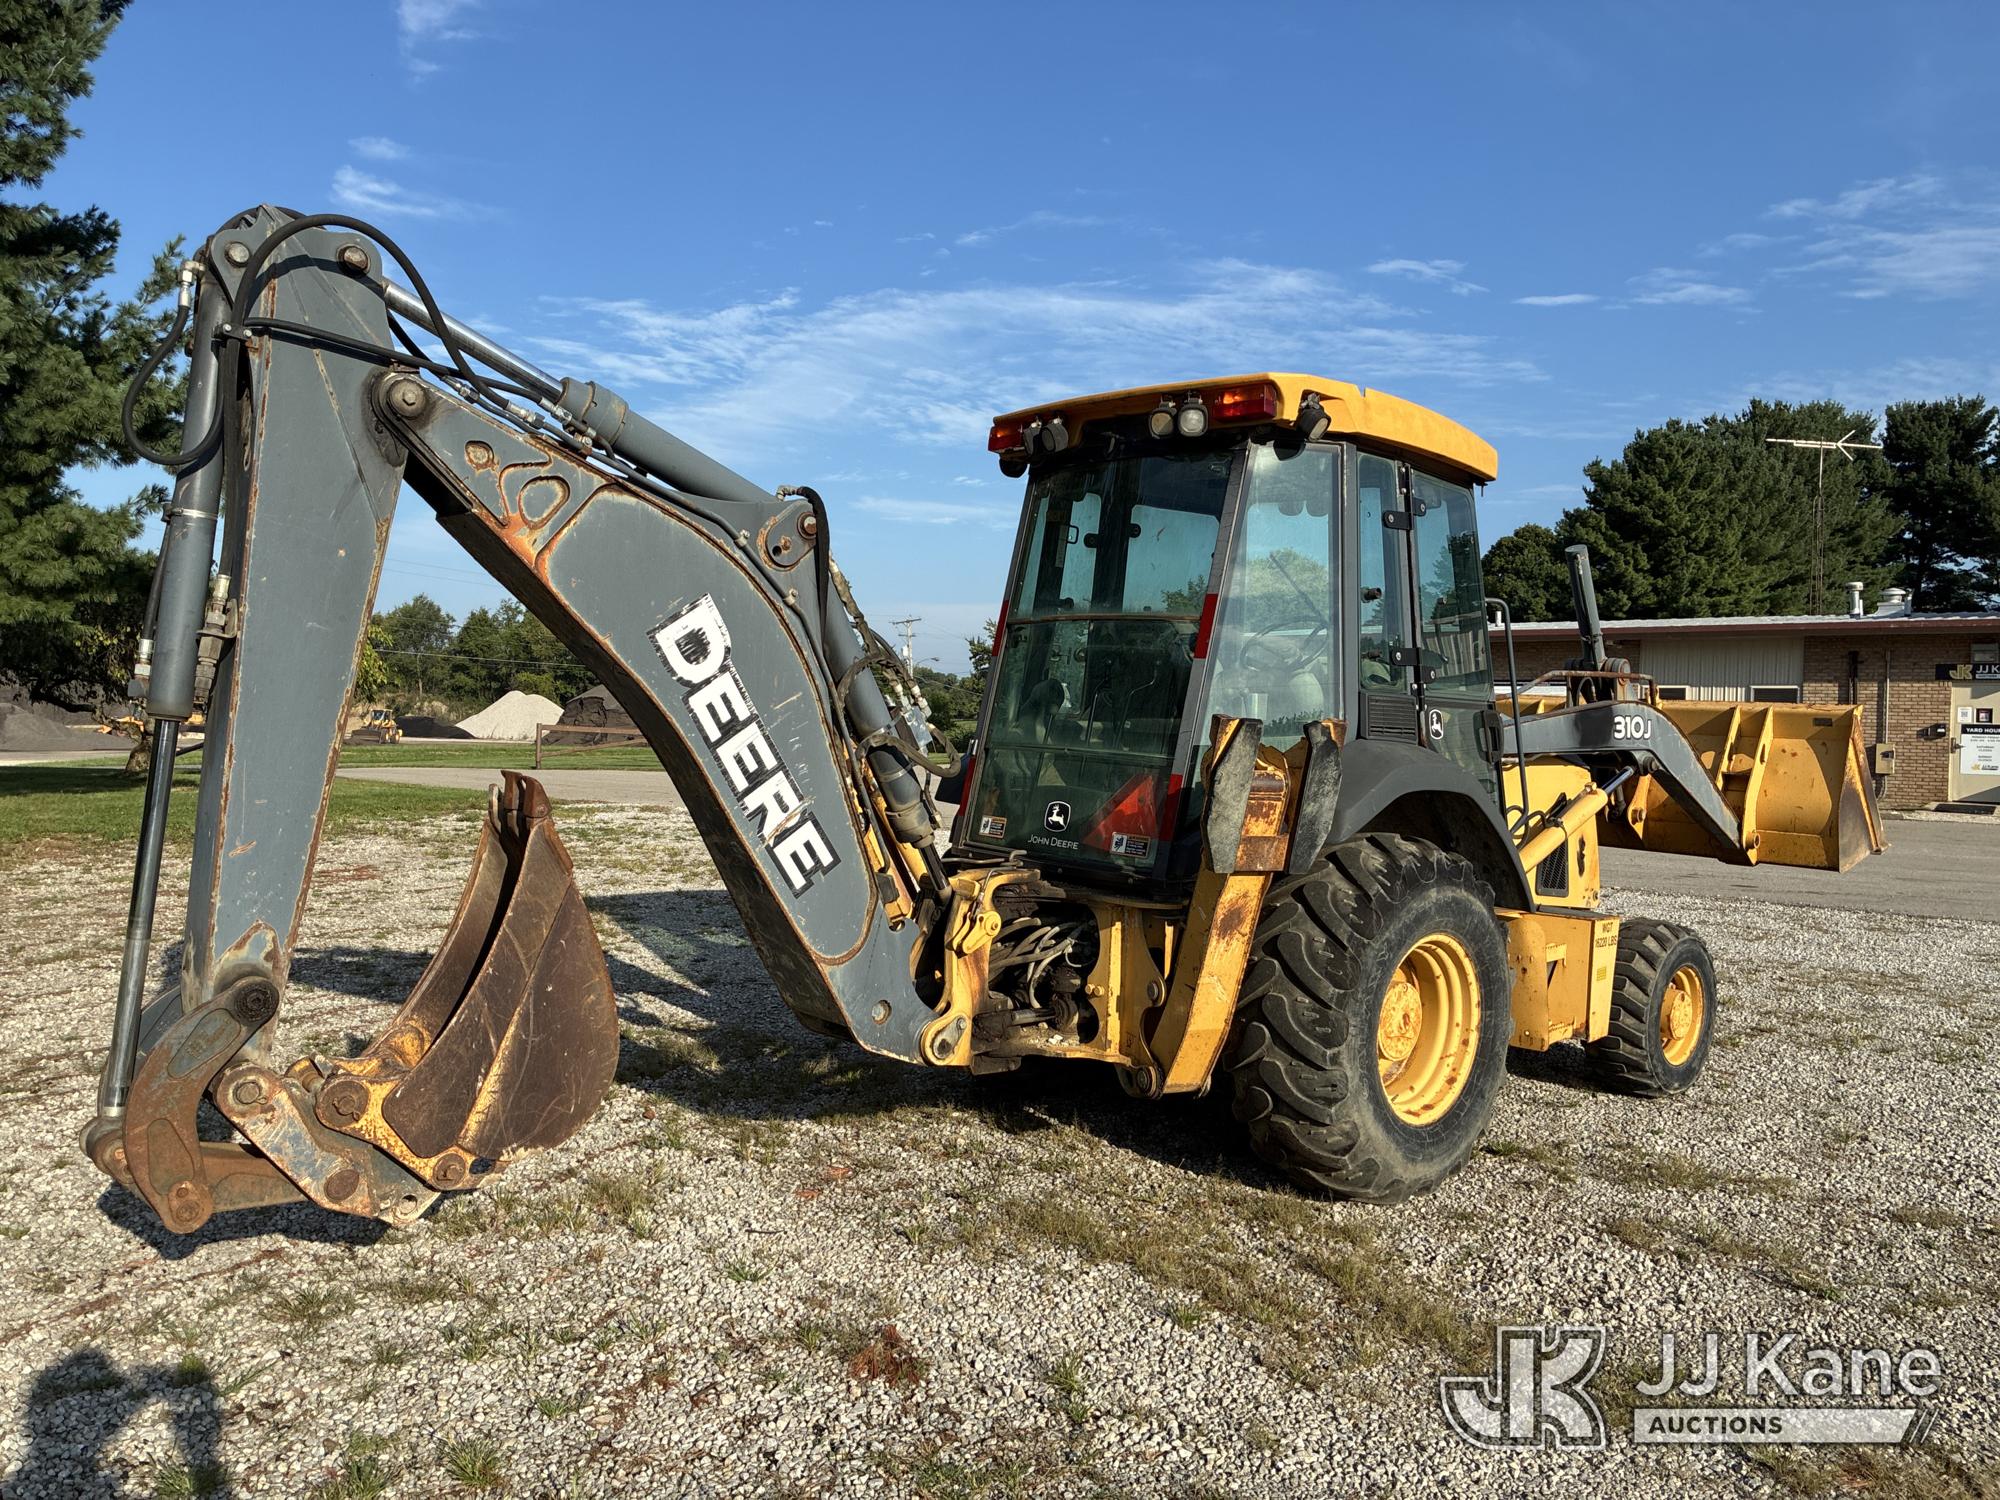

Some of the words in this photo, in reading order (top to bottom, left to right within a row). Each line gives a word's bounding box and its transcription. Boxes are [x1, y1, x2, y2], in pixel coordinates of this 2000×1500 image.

[1976, 664, 1989, 674] JJ
[1613, 715, 1652, 740] 310J
[650, 592, 838, 895] DEERE
[1027, 834, 1050, 846] JOHN
[1050, 836, 1079, 850] DEERE
[1608, 935, 1617, 946] LBS
